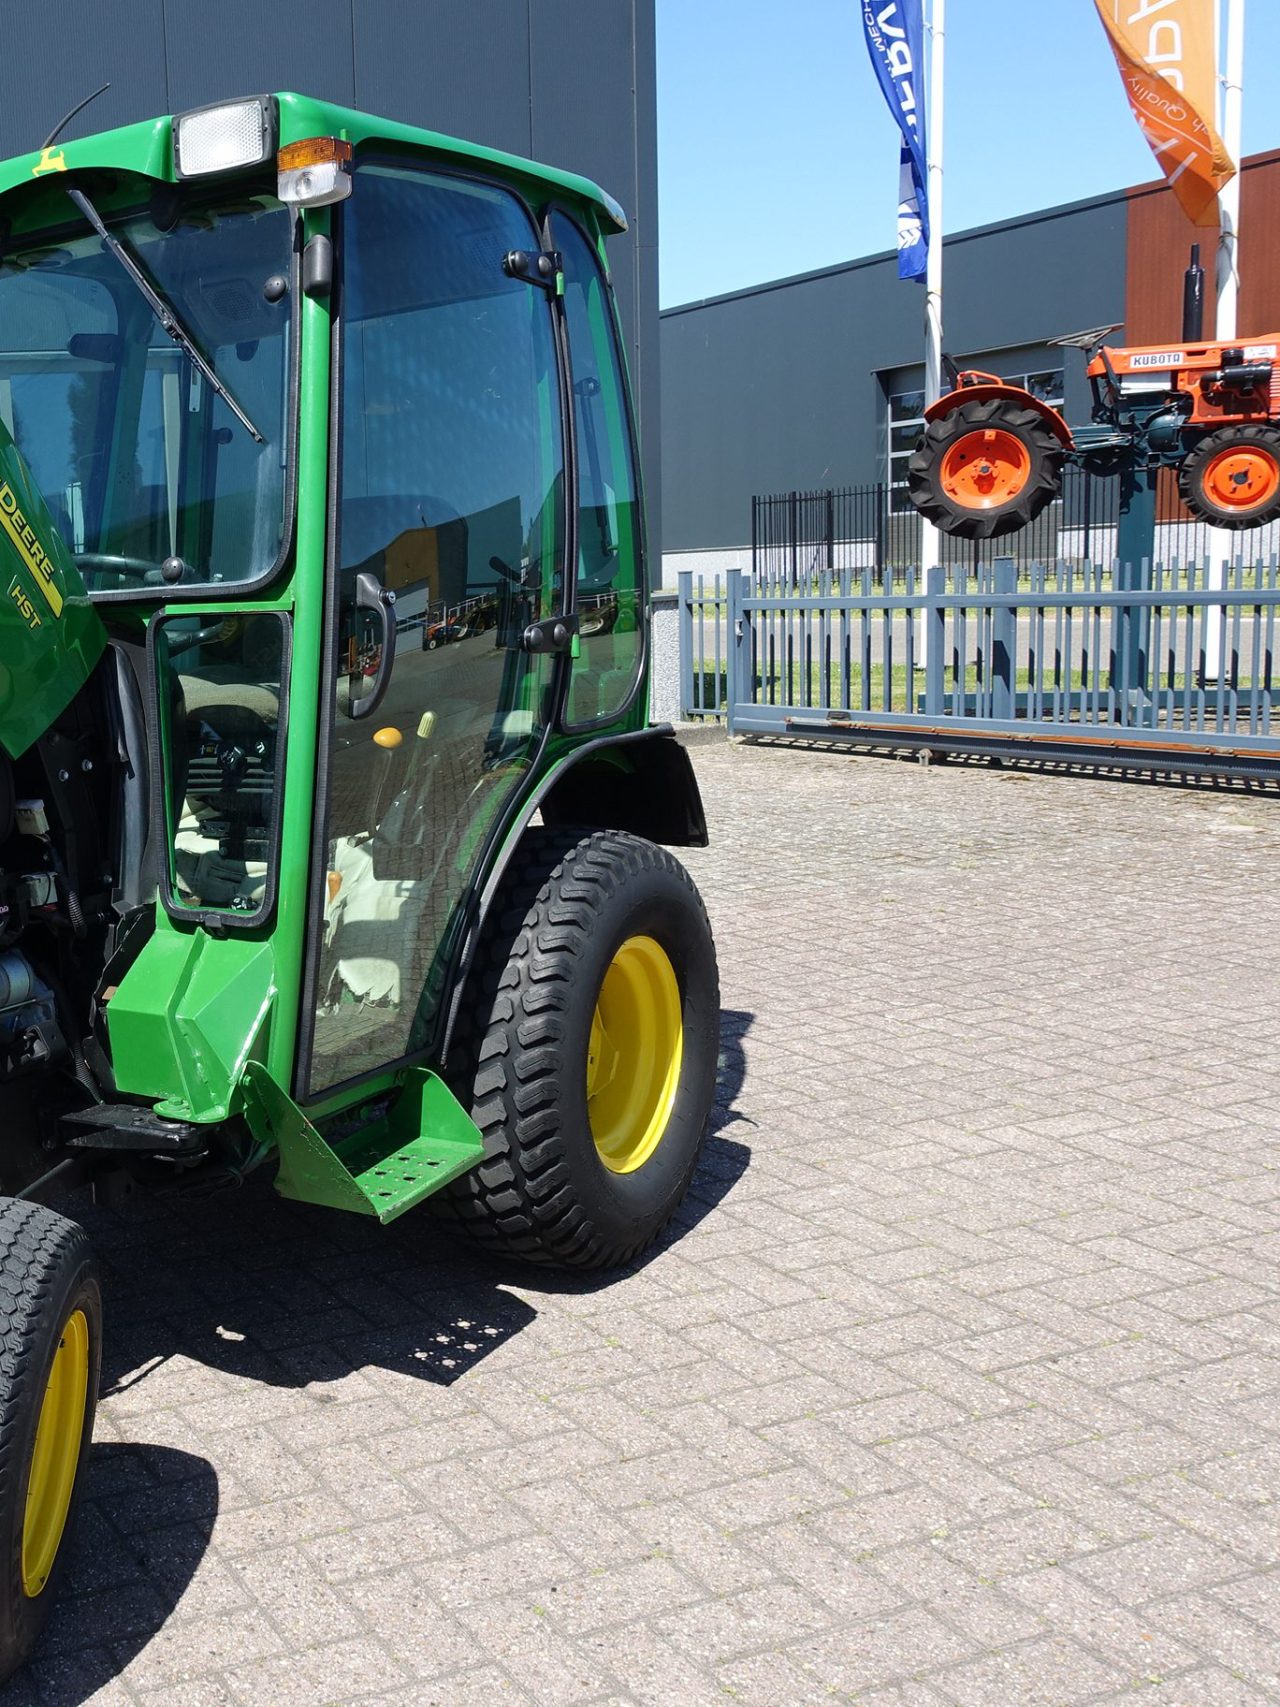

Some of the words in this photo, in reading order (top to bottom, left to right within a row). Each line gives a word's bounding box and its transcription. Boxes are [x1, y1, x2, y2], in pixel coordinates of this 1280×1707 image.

[1128, 76, 1187, 121] Quality
[1133, 354, 1180, 366] KUBOTA
[11, 584, 42, 629] HST
